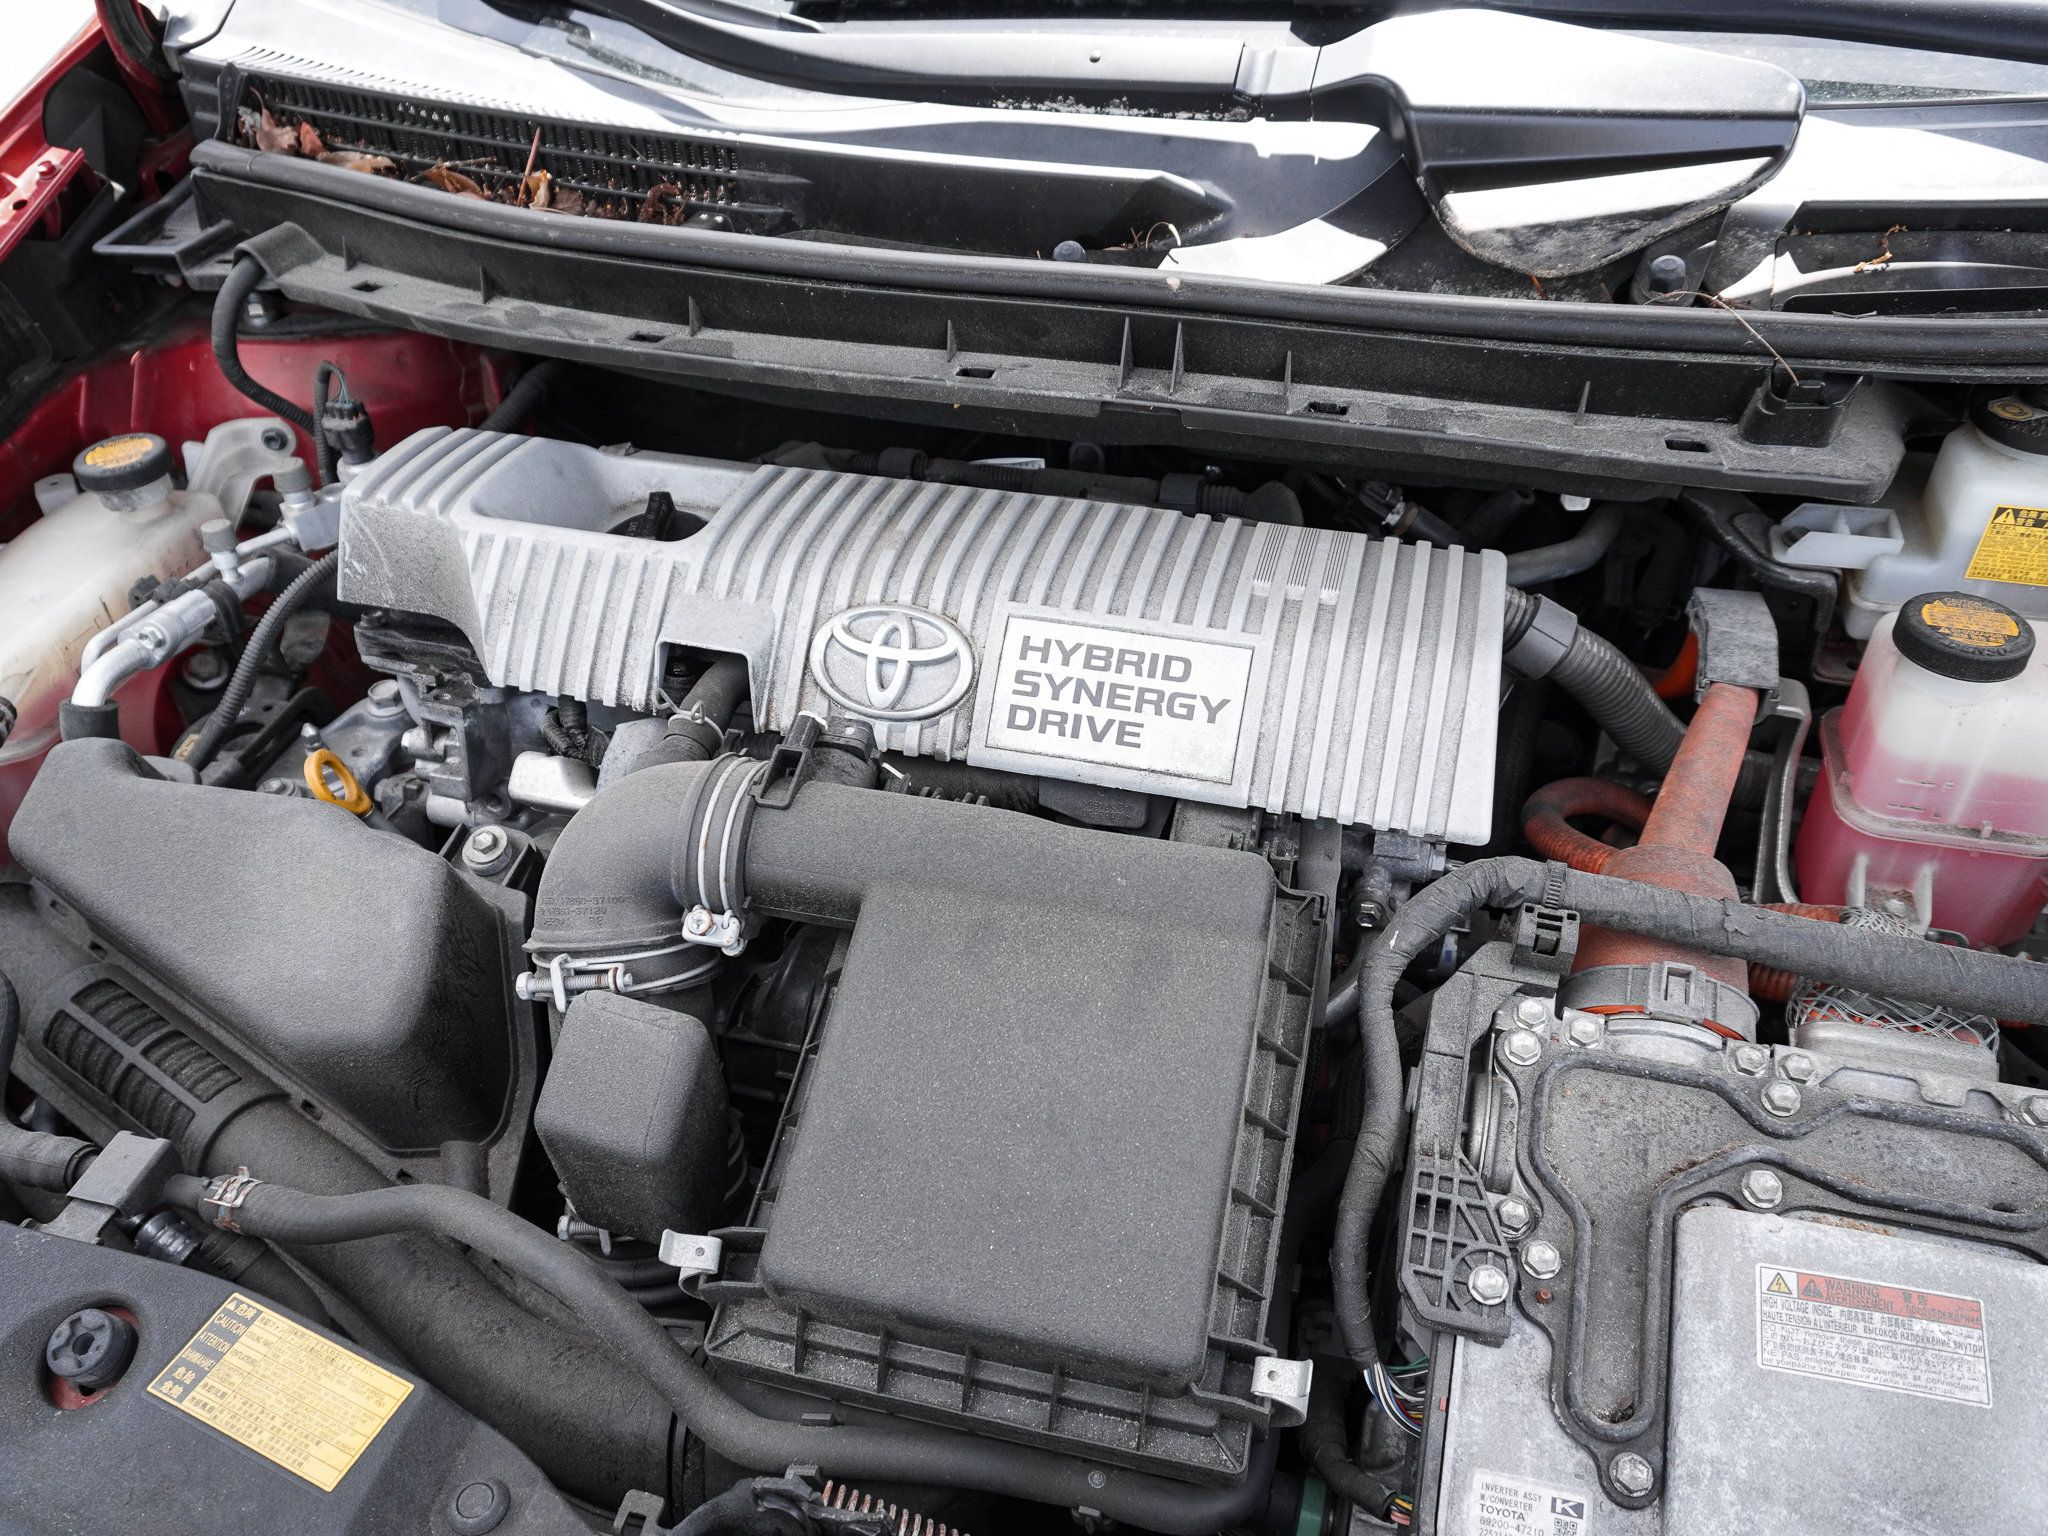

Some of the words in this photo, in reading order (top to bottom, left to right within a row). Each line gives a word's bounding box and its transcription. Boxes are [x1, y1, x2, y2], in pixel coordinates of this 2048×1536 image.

[1019, 635, 1192, 683] HYBRID
[1012, 670, 1231, 725] SYNERGY
[1006, 704, 1144, 748] DRIVE
[1825, 1278, 1879, 1298] WARNING
[1762, 1296, 1778, 1309] HIGH
[1780, 1298, 1809, 1314] VOLTAGE
[1812, 1303, 1833, 1318] INSIDE
[1826, 1291, 1894, 1312] AVERTISSEMENT
[213, 1313, 248, 1337] CAUTION
[1763, 1310, 1783, 1322] HAUTE
[1785, 1312, 1811, 1327] TENSION
[1905, 1304, 1981, 1325] предупреждение
[198, 1330, 233, 1354] ATTENTION
[1763, 1323, 1777, 1331] DO
[1781, 1326, 1800, 1336] NOT
[1804, 1331, 1836, 1341] remove
[1839, 1336, 1862, 1346] these
[1864, 1324, 1898, 1340] высокое
[1901, 1331, 1951, 1349] напряжение
[1954, 1341, 1984, 1355] внутри
[1763, 1349, 1777, 1357] NE
[1782, 1350, 1800, 1361] PAS
[1804, 1355, 1836, 1367] enlever
[1480, 1493, 1534, 1513] W/CONVERTER
[1481, 1482, 1519, 1498] INVERTER
[1522, 1491, 1543, 1503] ASSY
[1480, 1503, 1526, 1522] TOYOTA
[1479, 1515, 1545, 1536] G9200-47210
